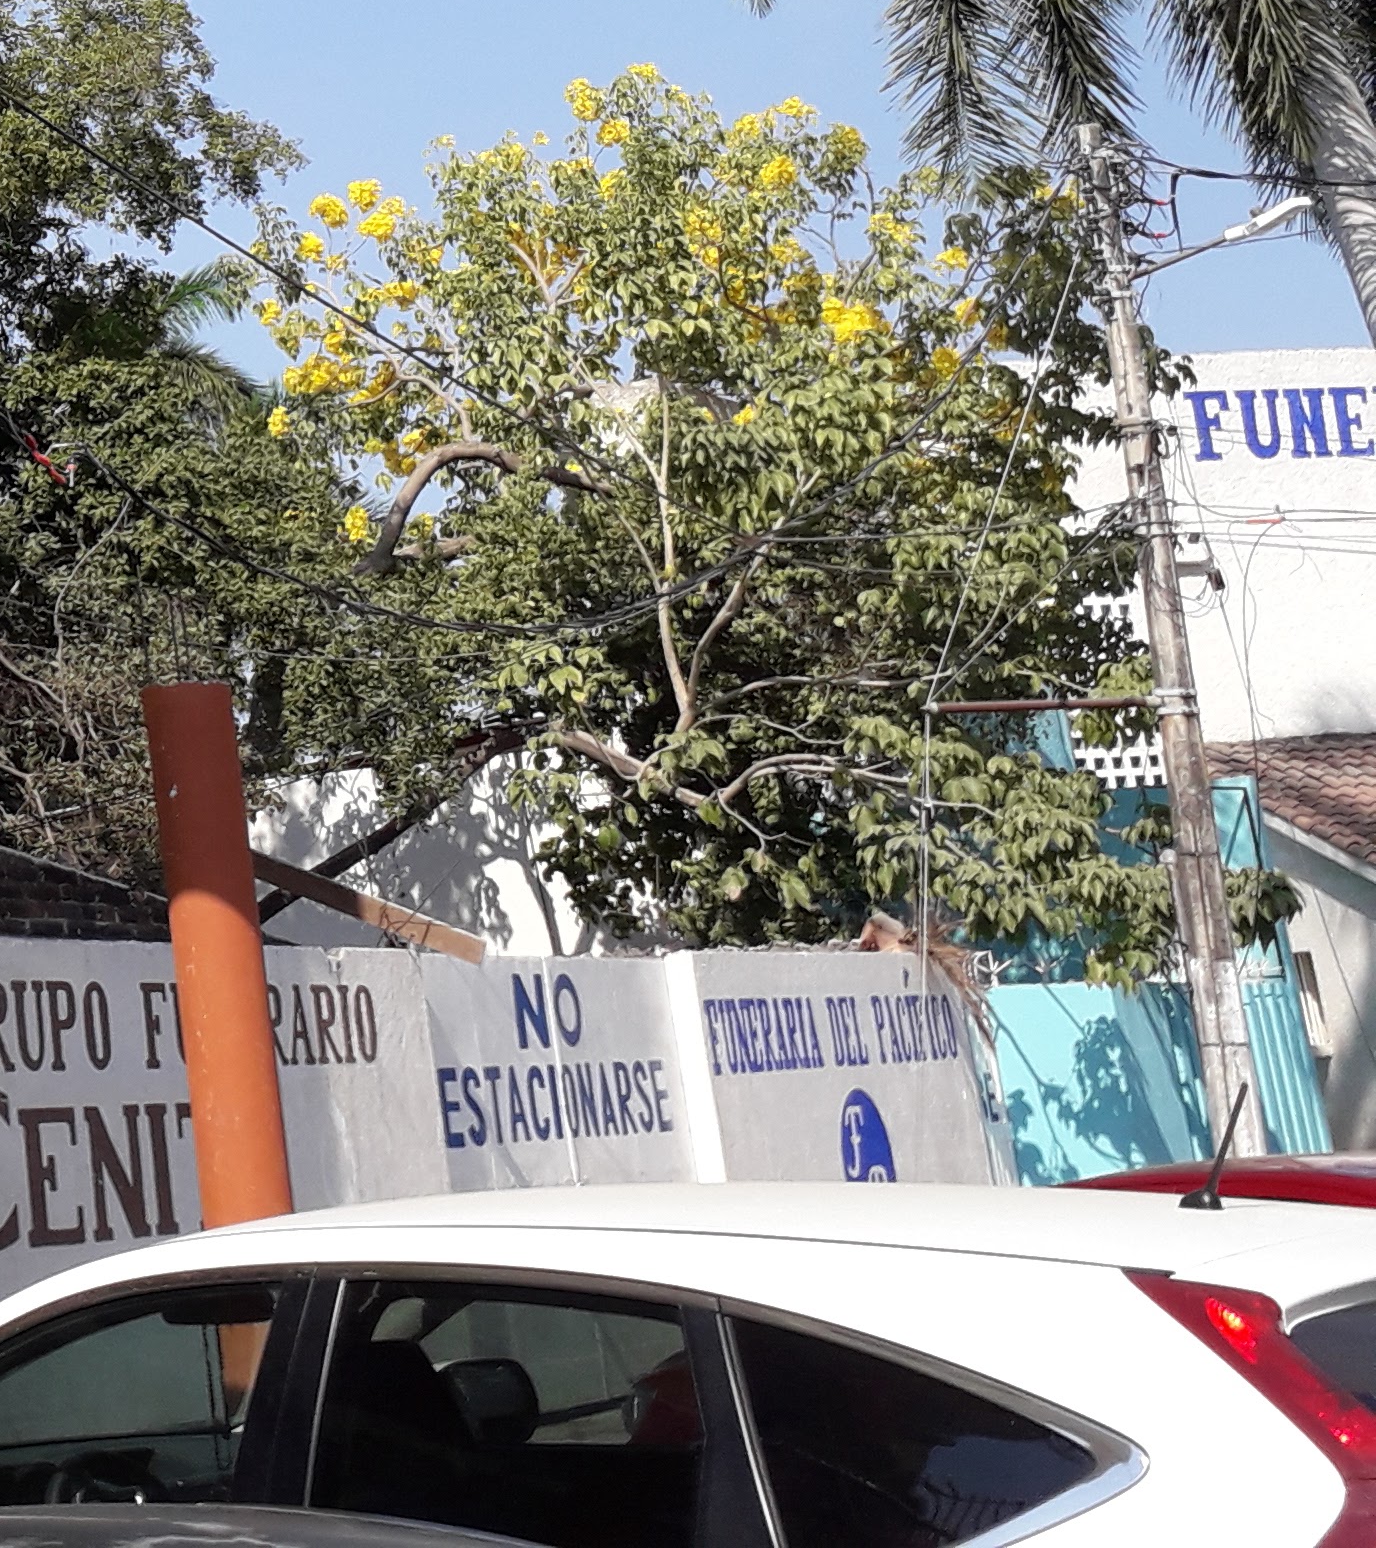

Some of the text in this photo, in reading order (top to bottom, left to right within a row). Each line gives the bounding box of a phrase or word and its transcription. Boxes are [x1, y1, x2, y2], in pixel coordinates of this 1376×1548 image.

[1182, 387, 1376, 462] FUNE
[139, 981, 378, 1070] FRARIO
[512, 973, 583, 1050] NO
[703, 996, 826, 1076] FUNERARIA
[824, 996, 870, 1067] DEL
[437, 1060, 675, 1150] ESTACIONARSE
